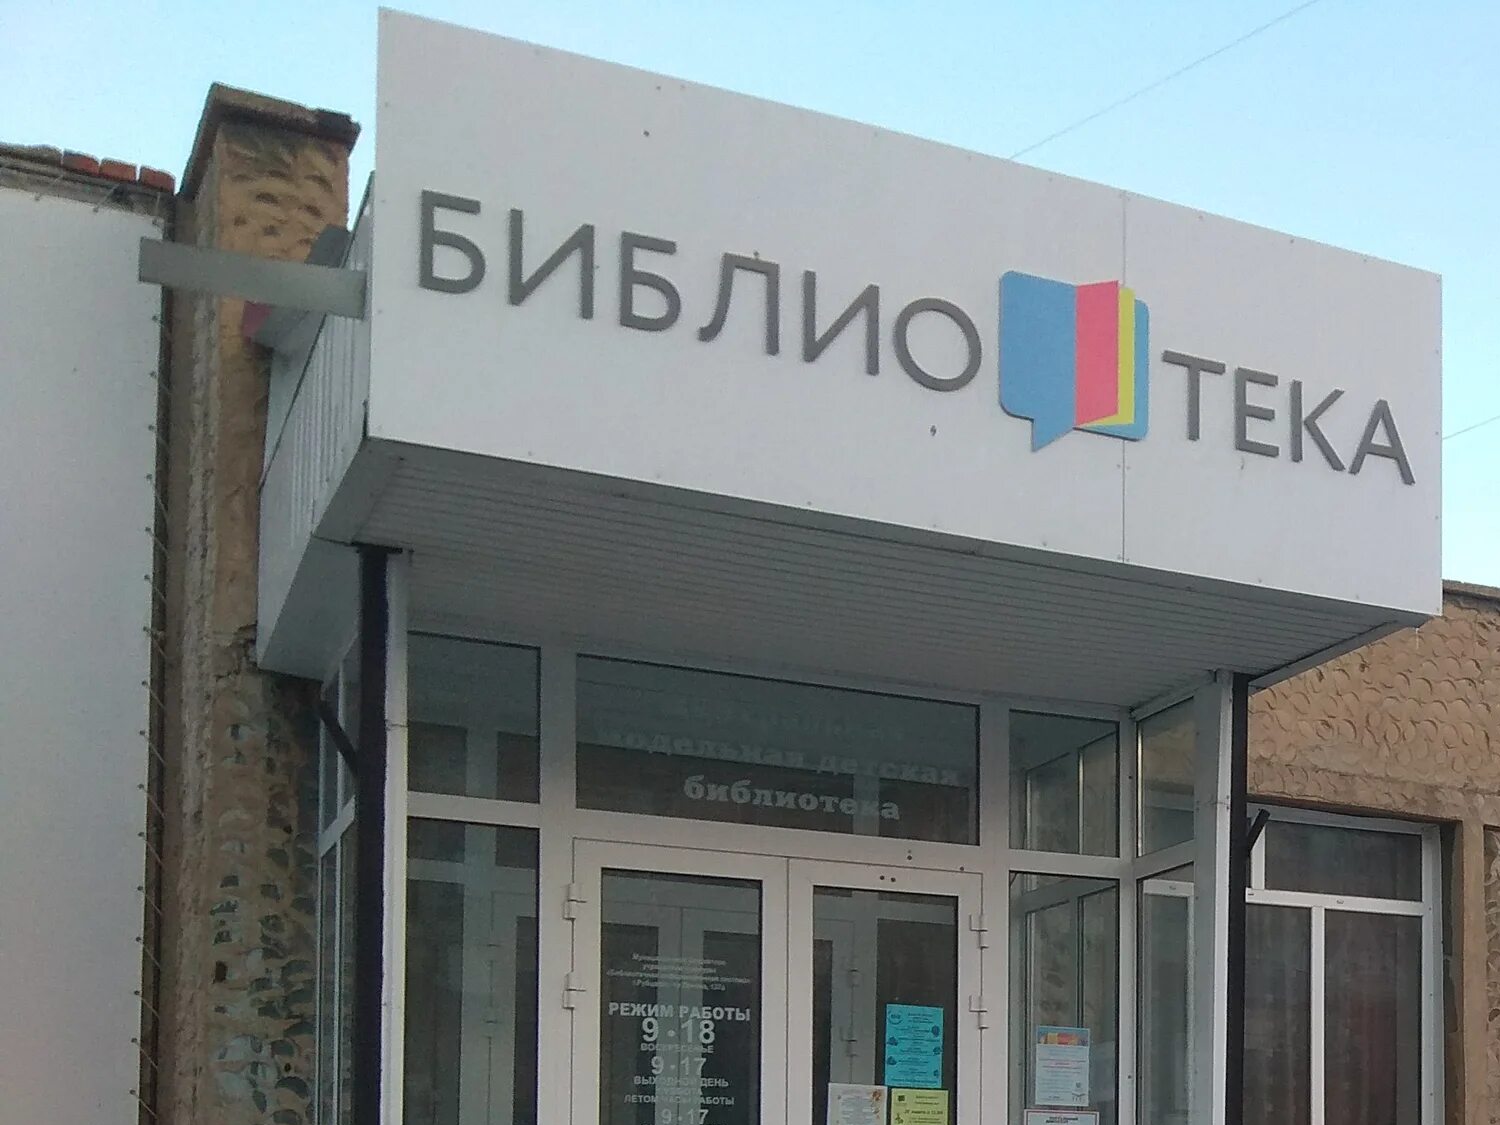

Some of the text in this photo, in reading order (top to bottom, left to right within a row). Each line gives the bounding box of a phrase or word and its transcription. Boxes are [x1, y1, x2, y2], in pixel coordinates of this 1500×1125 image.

[683, 773, 900, 820] библиотека
[608, 1002, 751, 1021] РЕЖИМ РАБОТЫ
[681, 1018, 715, 1044] 18
[700, 1077, 730, 1088] ДЕНЬ
